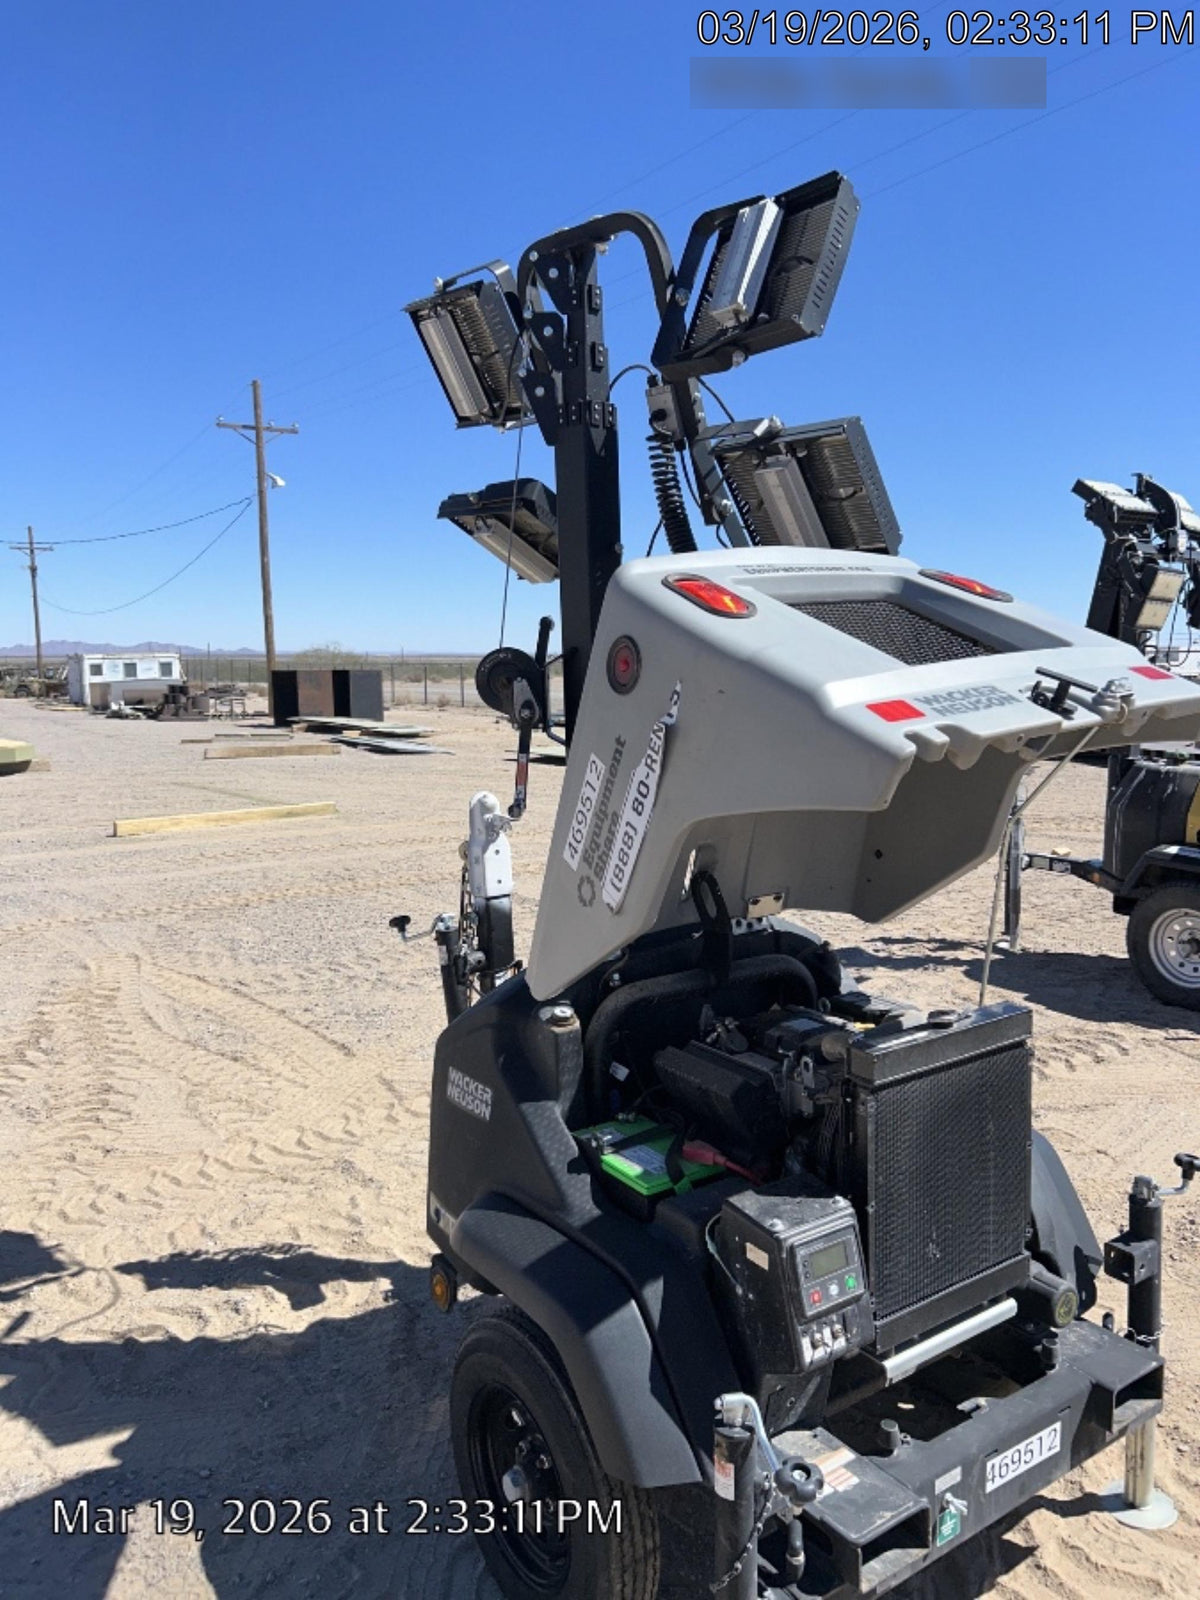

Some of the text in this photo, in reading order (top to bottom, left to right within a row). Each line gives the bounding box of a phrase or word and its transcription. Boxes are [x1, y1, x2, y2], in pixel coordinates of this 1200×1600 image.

[914, 686, 1008, 706] WACKER
[930, 694, 1023, 717] NEUSON
[567, 759, 604, 860] 469512
[583, 734, 627, 870] Equipment
[447, 1082, 491, 1121] NEUSON
[448, 1066, 492, 1105] WACKER
[986, 1428, 1059, 1485] 469512
